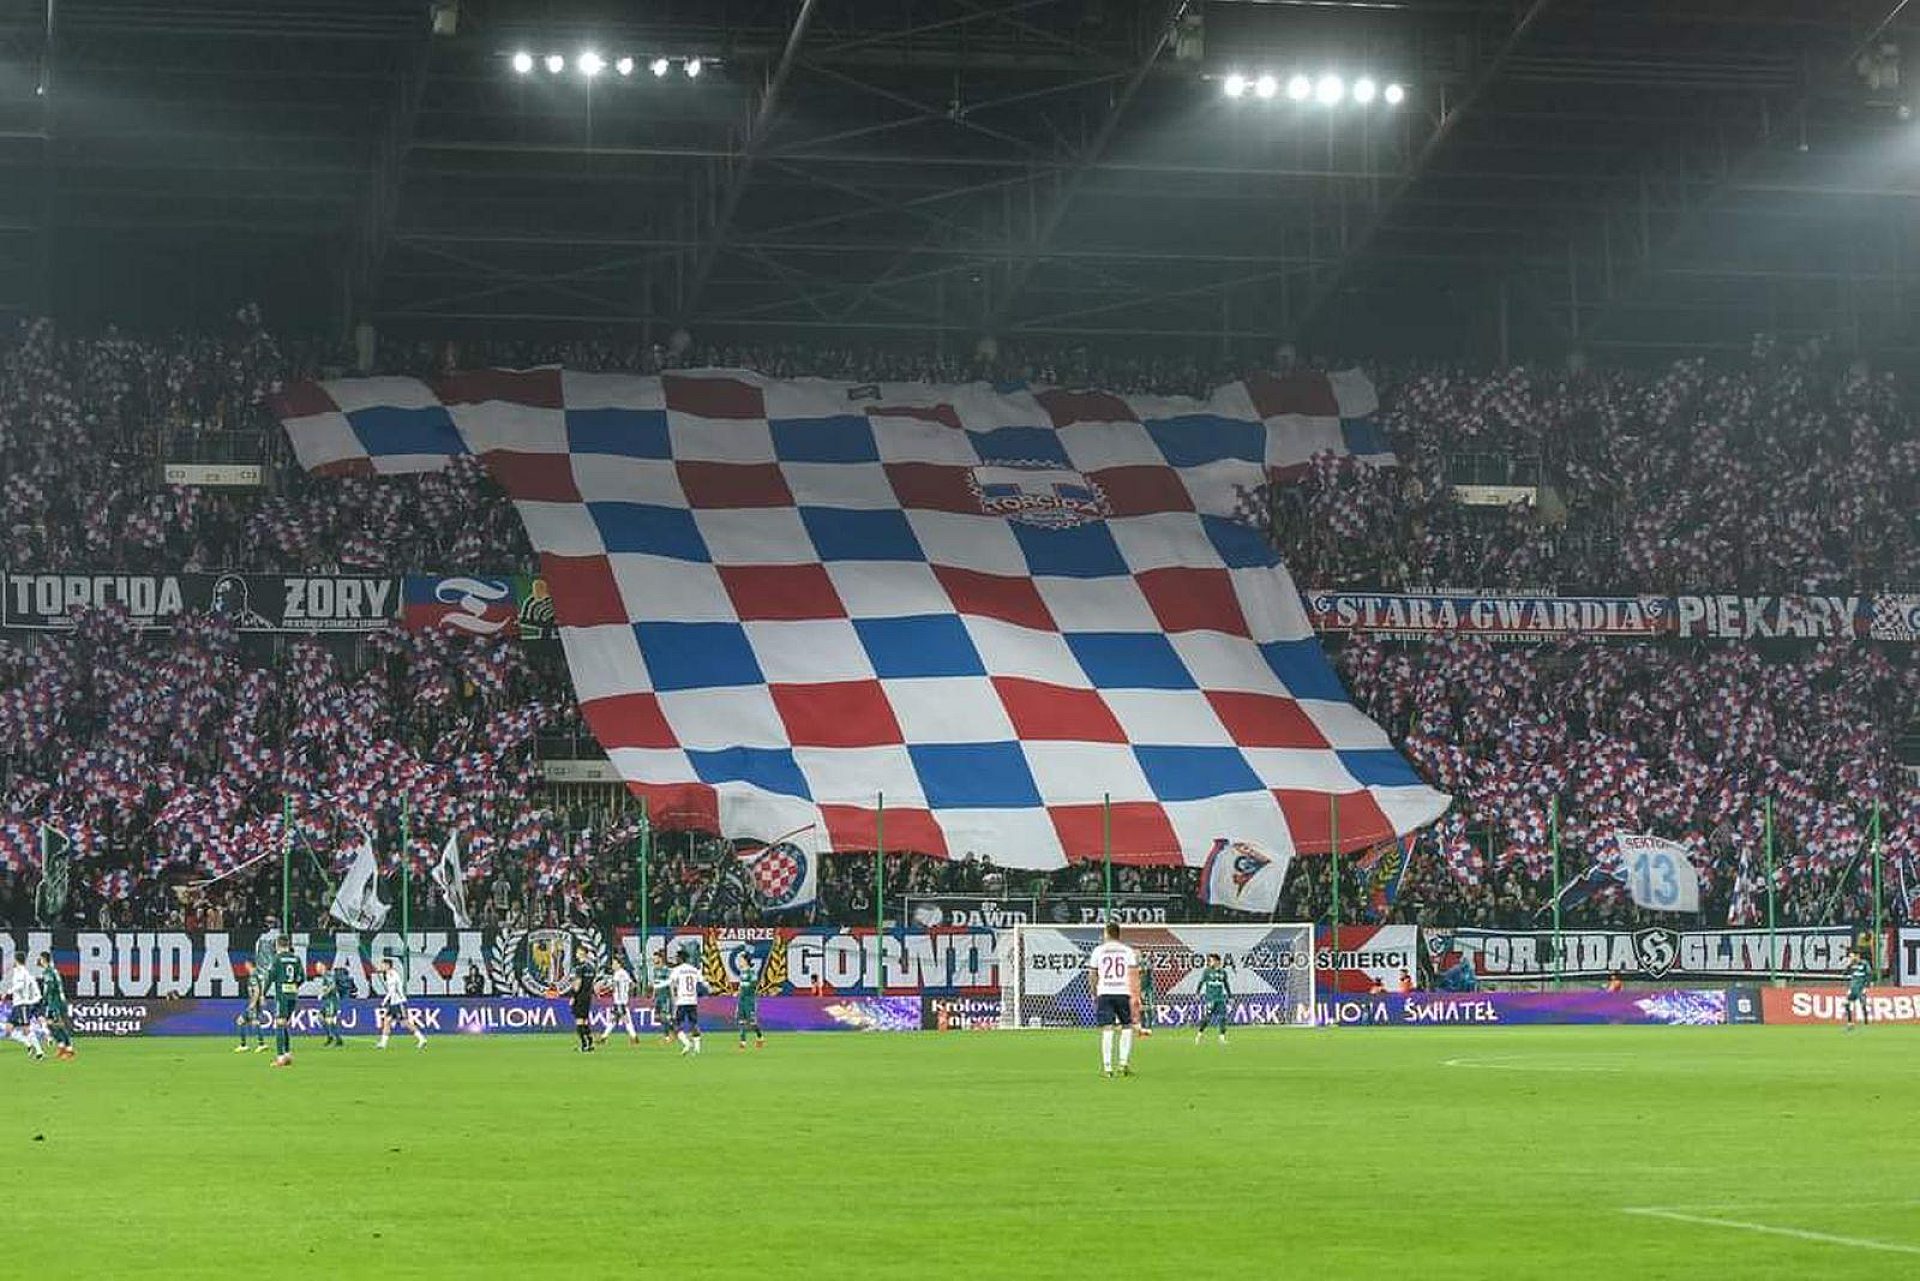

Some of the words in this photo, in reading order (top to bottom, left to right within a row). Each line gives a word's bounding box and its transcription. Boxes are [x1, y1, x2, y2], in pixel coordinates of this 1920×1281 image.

[10, 575, 184, 616] TORCIDA
[1337, 595, 1458, 629] STARA
[1470, 598, 1645, 631] GWARDIA
[1678, 595, 1860, 639] PIEKARY
[1634, 853, 1678, 905] 13
[951, 910, 1027, 927] DAWID
[1081, 907, 1166, 924] PASTOR
[718, 927, 774, 941] ZABRZE
[77, 932, 239, 997] RUDA
[1681, 934, 1853, 971] GLIWICE
[1102, 956, 1126, 979] 26
[67, 1002, 146, 1017] Królowa
[458, 1006, 557, 1029] MILIONA
[1404, 998, 1500, 1022] ŚWIATEŁ
[1792, 992, 1920, 1021] SUPERB
